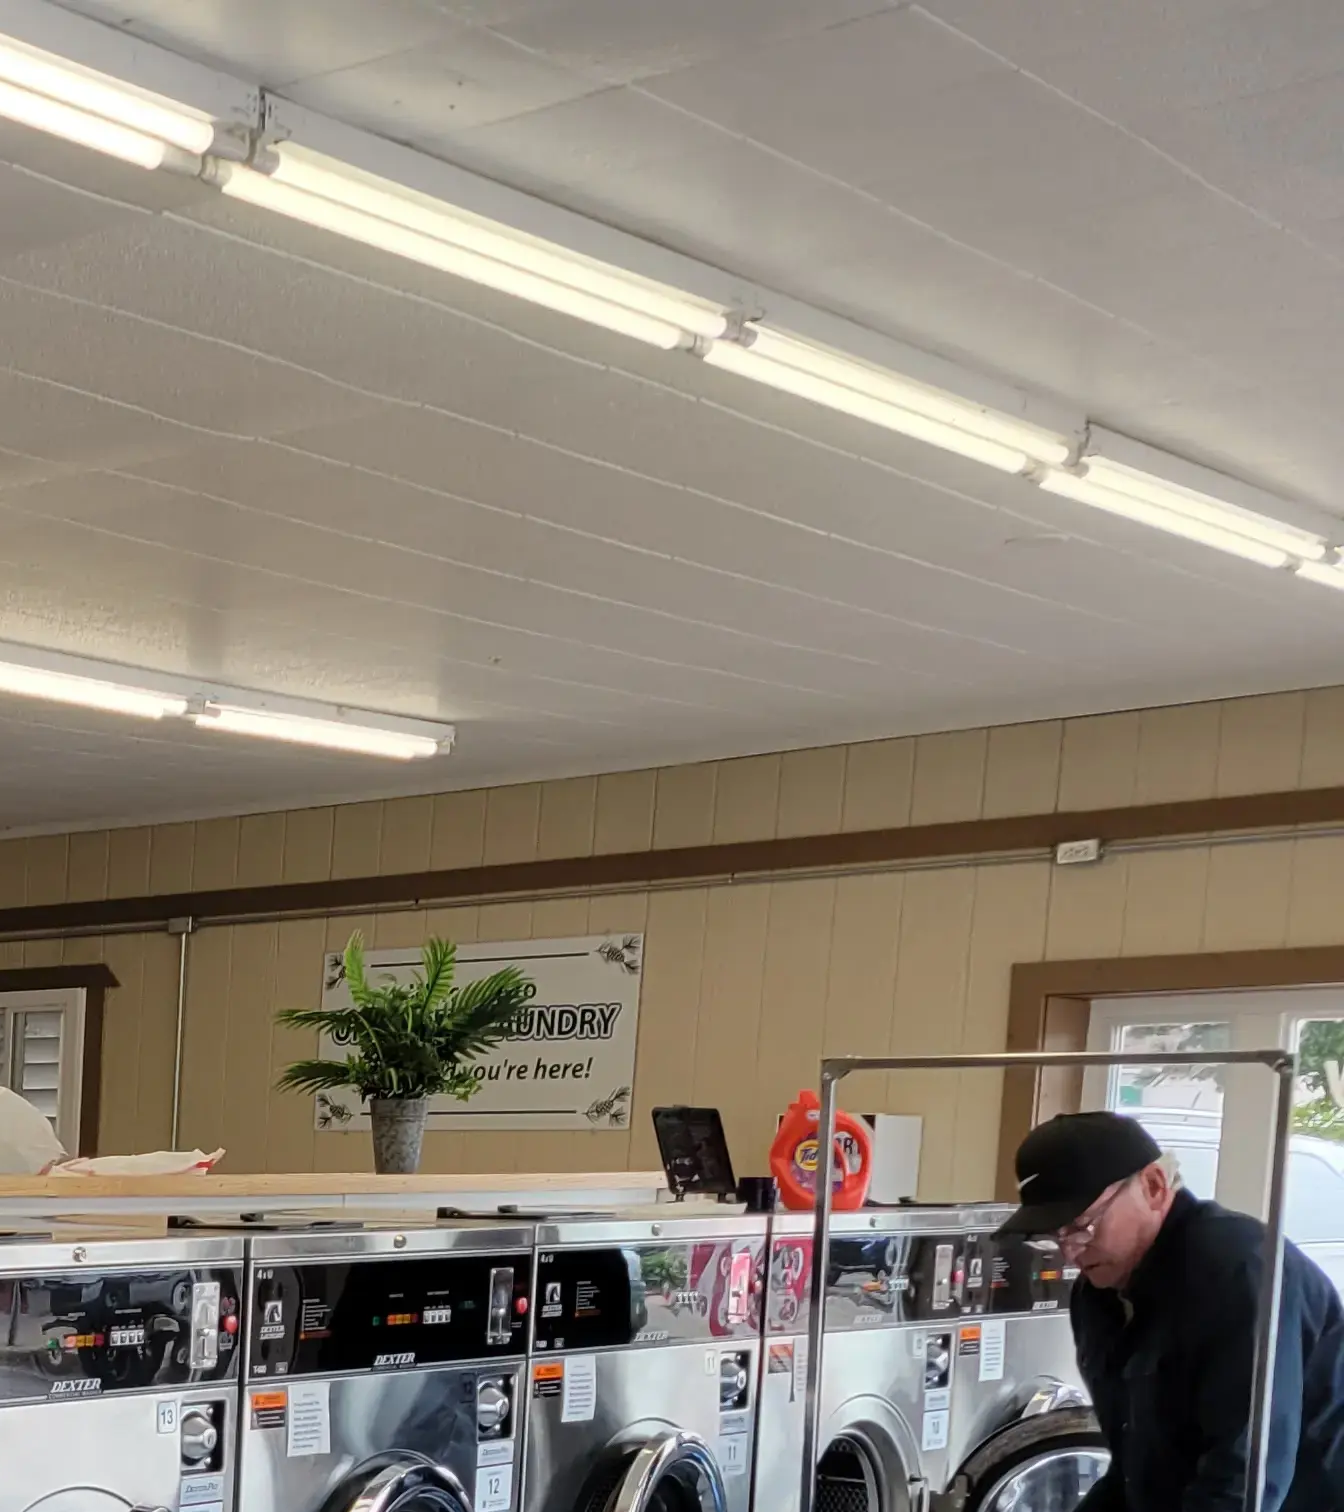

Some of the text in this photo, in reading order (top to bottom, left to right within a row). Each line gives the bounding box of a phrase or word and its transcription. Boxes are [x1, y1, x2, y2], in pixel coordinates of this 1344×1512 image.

[533, 1056, 593, 1080] here!
[373, 1352, 416, 1366] DEXTER
[51, 1377, 102, 1393] DEXTER
[161, 1409, 173, 1425] 13
[488, 1477, 500, 1496] 12
